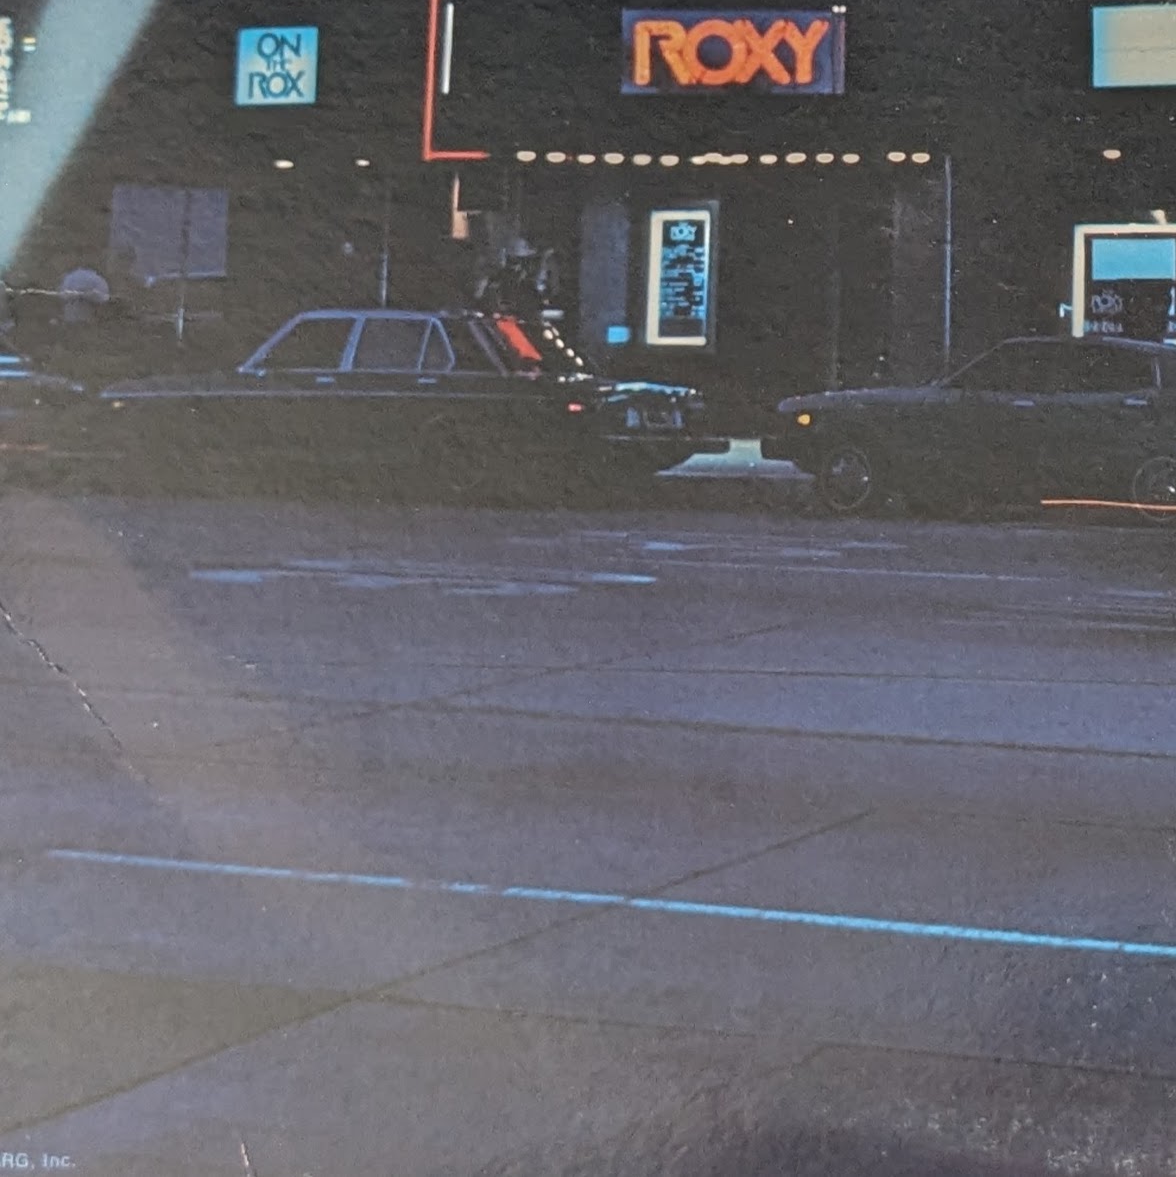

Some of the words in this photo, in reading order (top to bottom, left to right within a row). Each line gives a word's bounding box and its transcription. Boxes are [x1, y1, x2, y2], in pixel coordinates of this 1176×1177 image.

[257, 32, 302, 60] ON
[633, 18, 830, 86] ROXY
[248, 71, 305, 99] ROX
[0, 1151, 35, 1170] RG,
[41, 1152, 77, 1168] Inc.
